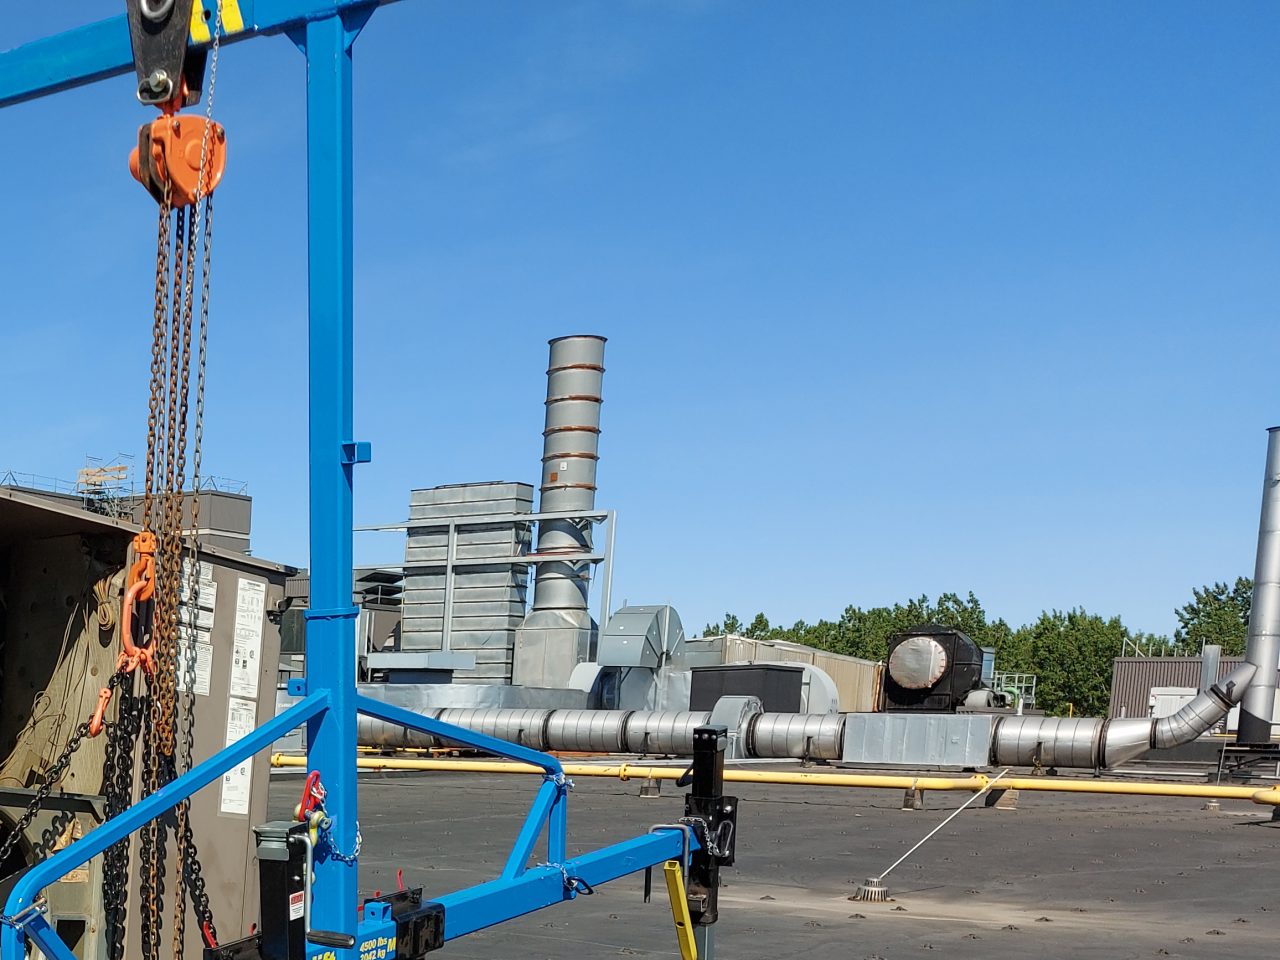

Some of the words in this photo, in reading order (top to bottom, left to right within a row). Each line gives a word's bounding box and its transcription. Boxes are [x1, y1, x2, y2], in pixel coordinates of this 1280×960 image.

[360, 939, 377, 952] 4500
[377, 937, 387, 947] lbs
[377, 949, 385, 959] kg
